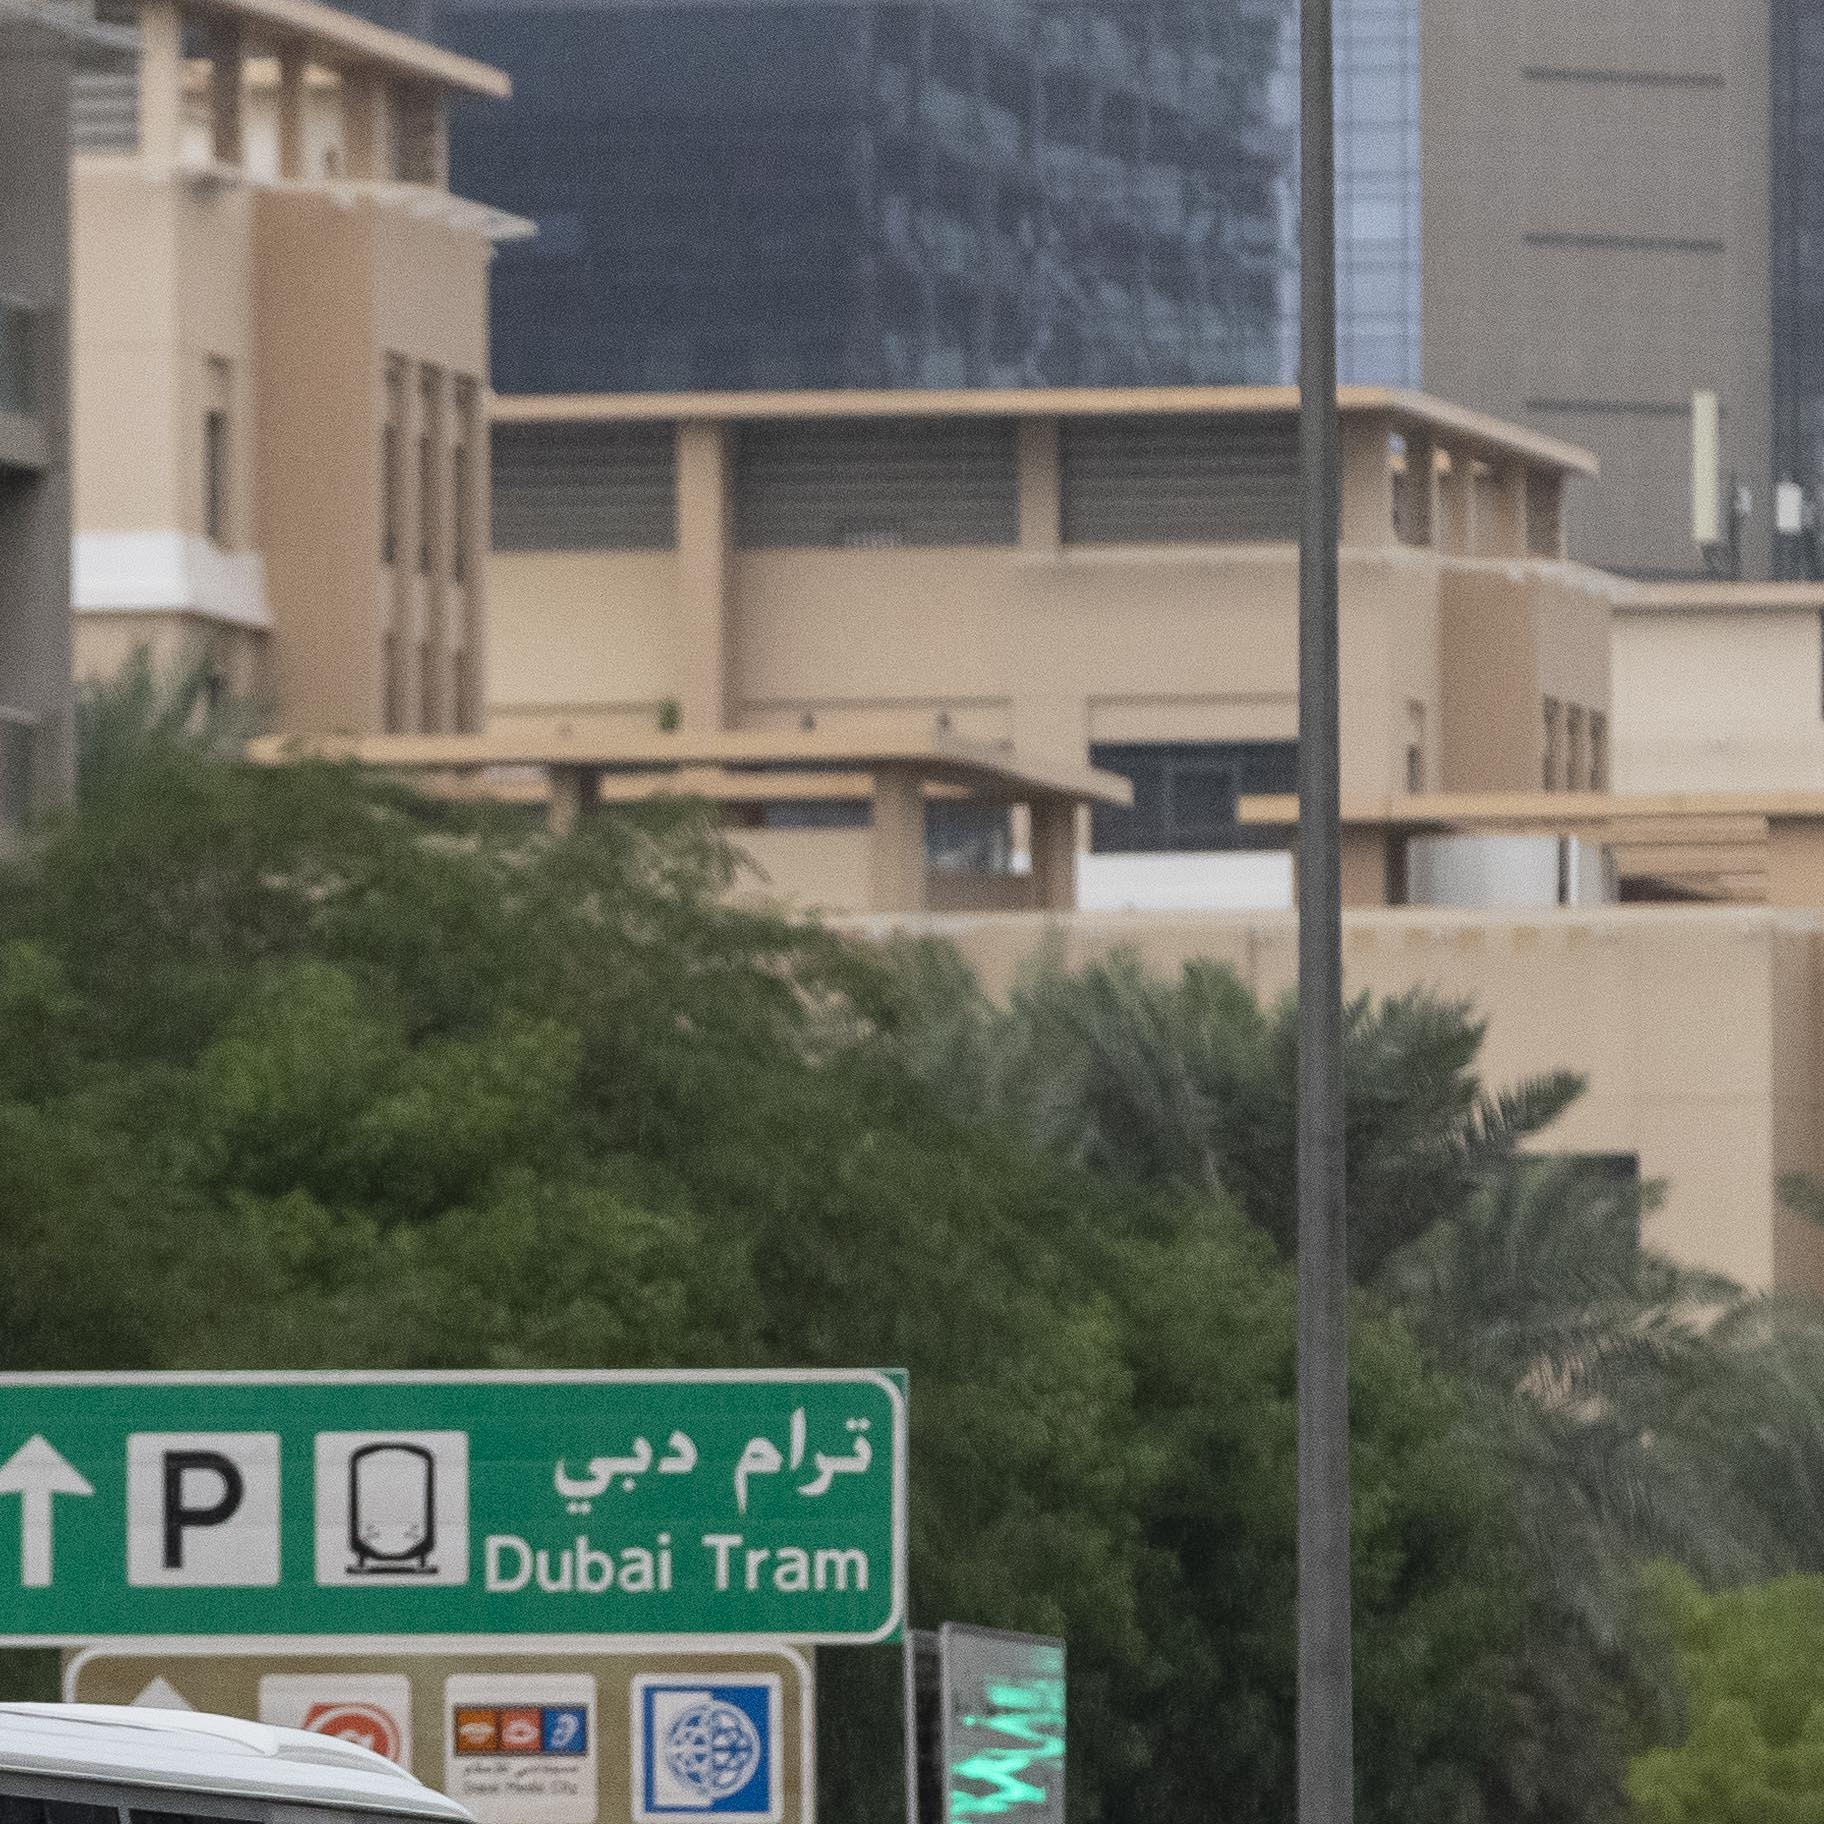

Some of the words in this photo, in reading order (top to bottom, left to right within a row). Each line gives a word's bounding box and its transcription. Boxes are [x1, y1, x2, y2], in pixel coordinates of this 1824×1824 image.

[553, 1431, 697, 1514] دبي
[734, 1408, 873, 1509] ترام
[162, 1449, 245, 1570] P
[485, 1532, 672, 1593] Dubai
[702, 1534, 869, 1592] Tram
